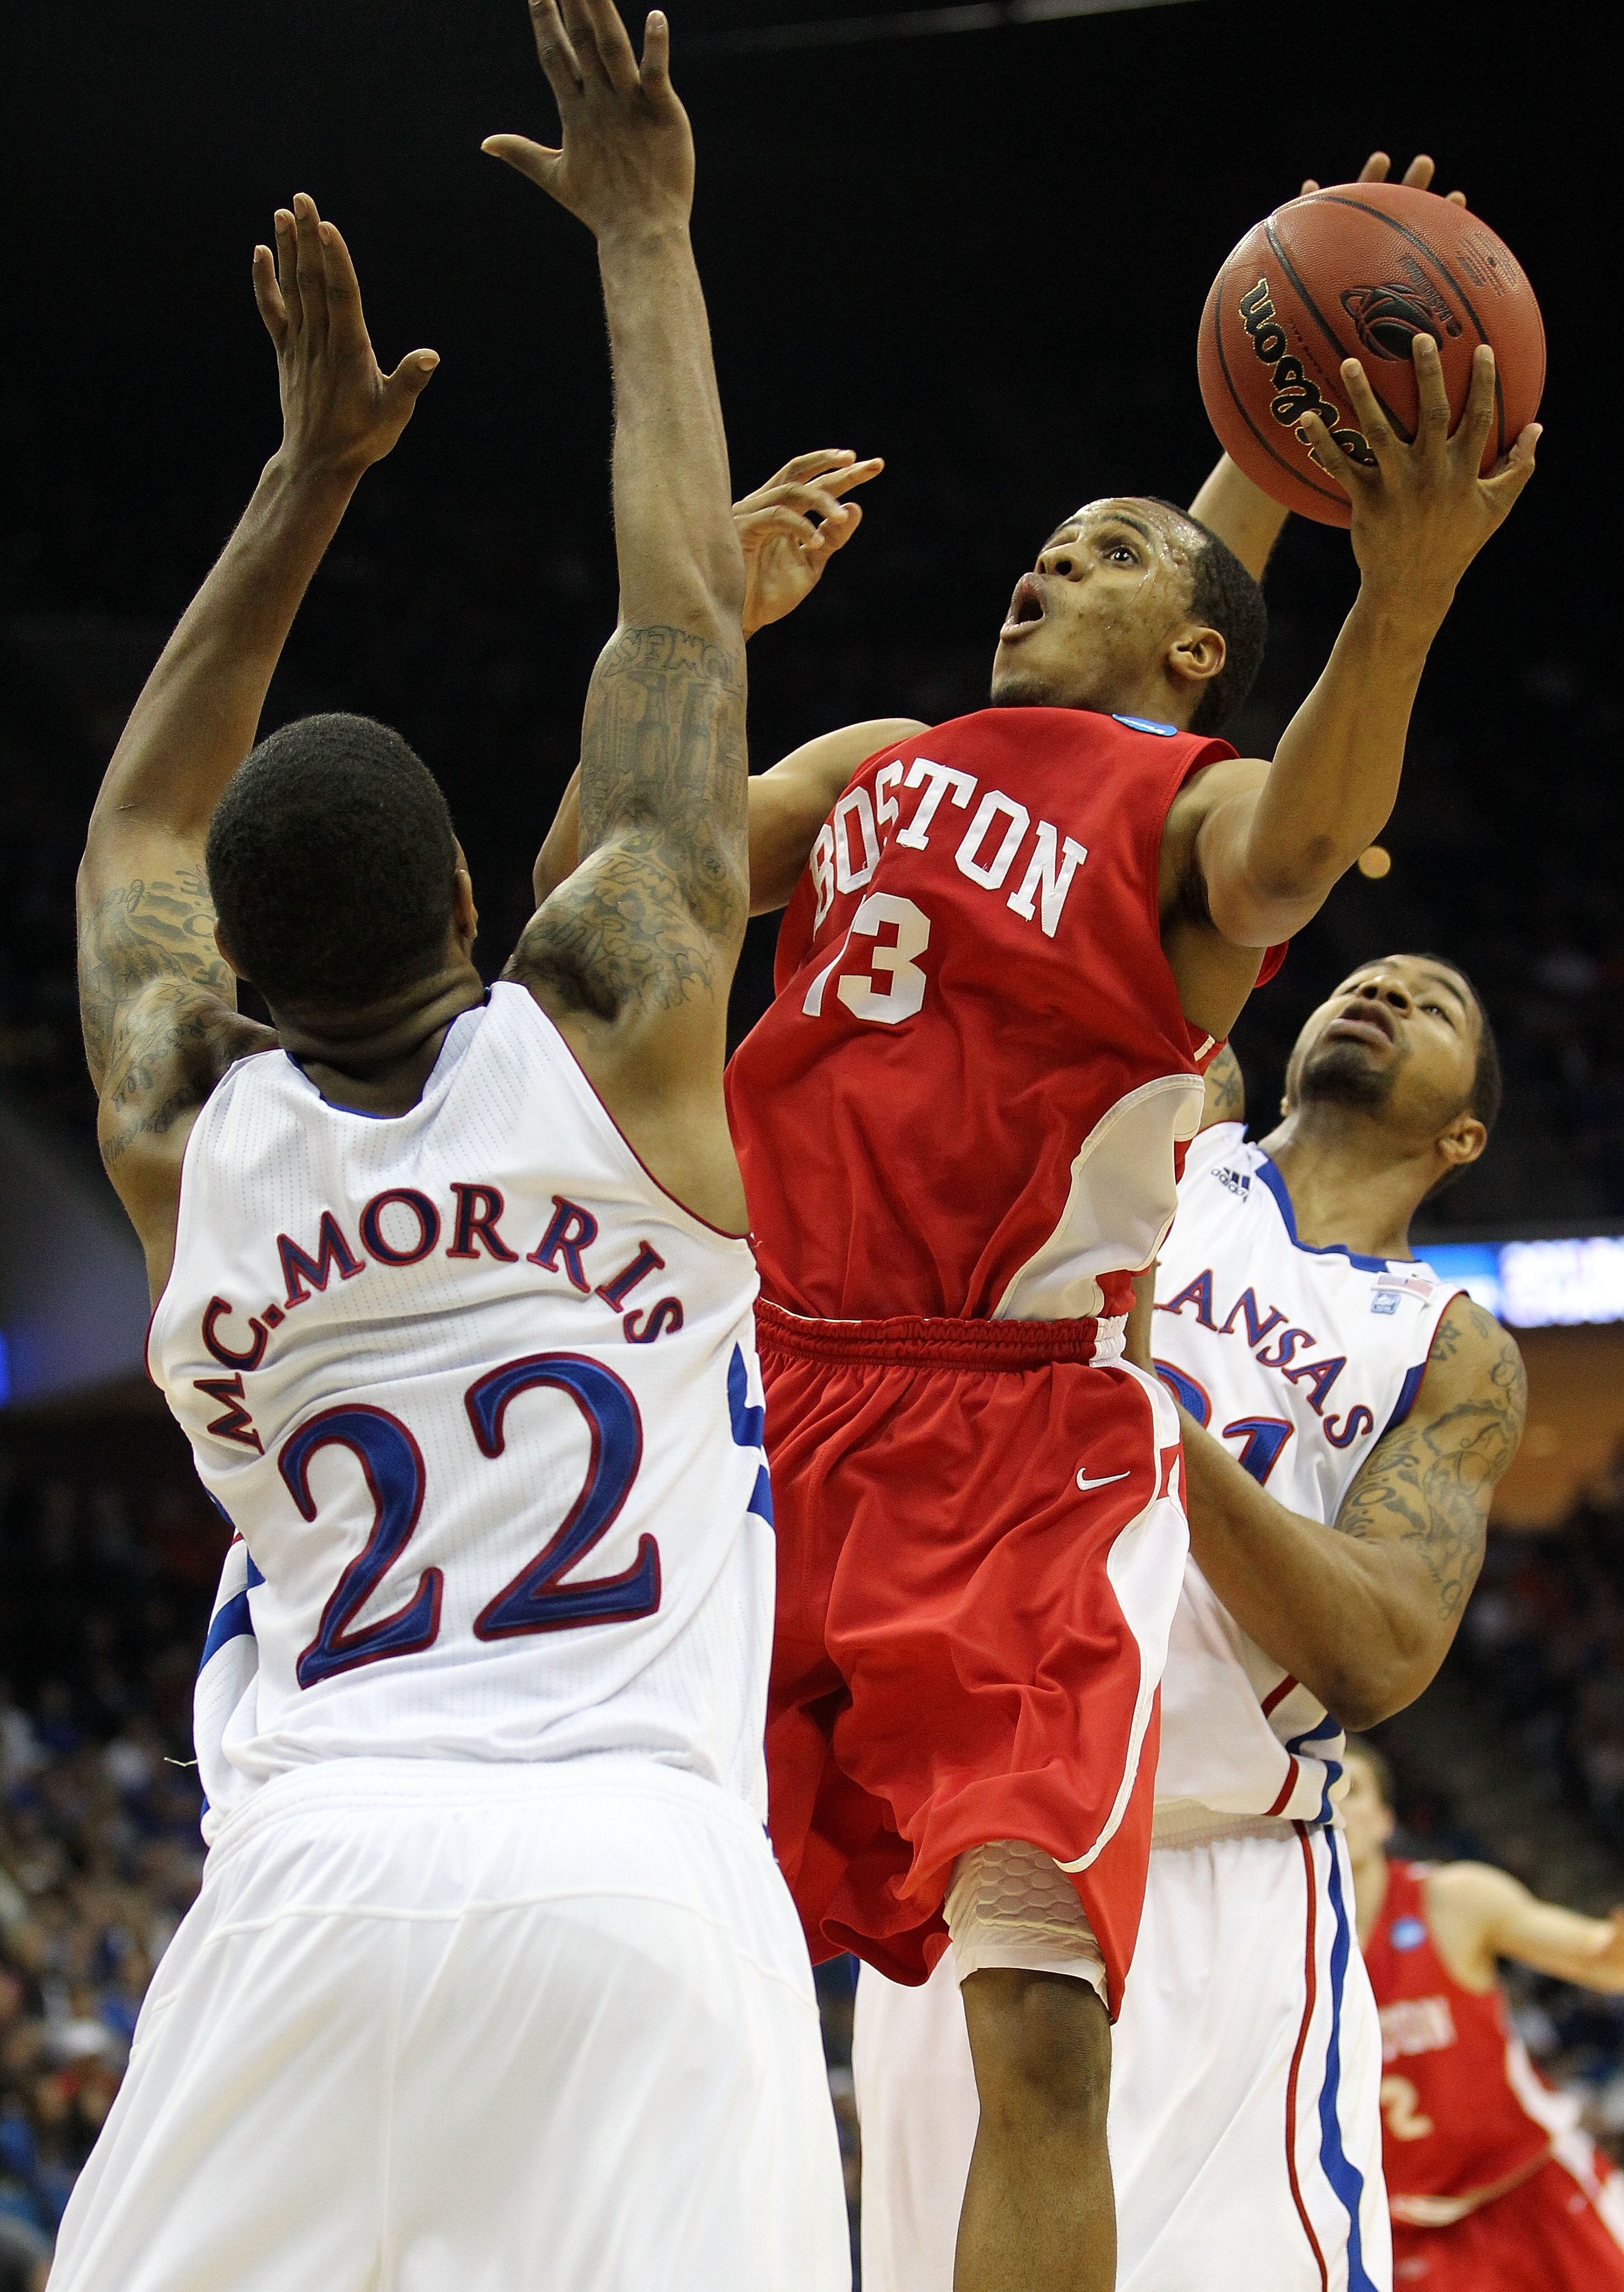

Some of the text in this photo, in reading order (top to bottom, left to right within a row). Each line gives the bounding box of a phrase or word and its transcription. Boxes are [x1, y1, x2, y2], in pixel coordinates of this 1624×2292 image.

[810, 757, 1088, 939] BOSTON
[802, 892, 931, 1025] 13
[193, 1182, 684, 1455] MC.MORRIS
[1154, 1268, 1373, 1449] ANSAS
[277, 1351, 662, 1690] 22
